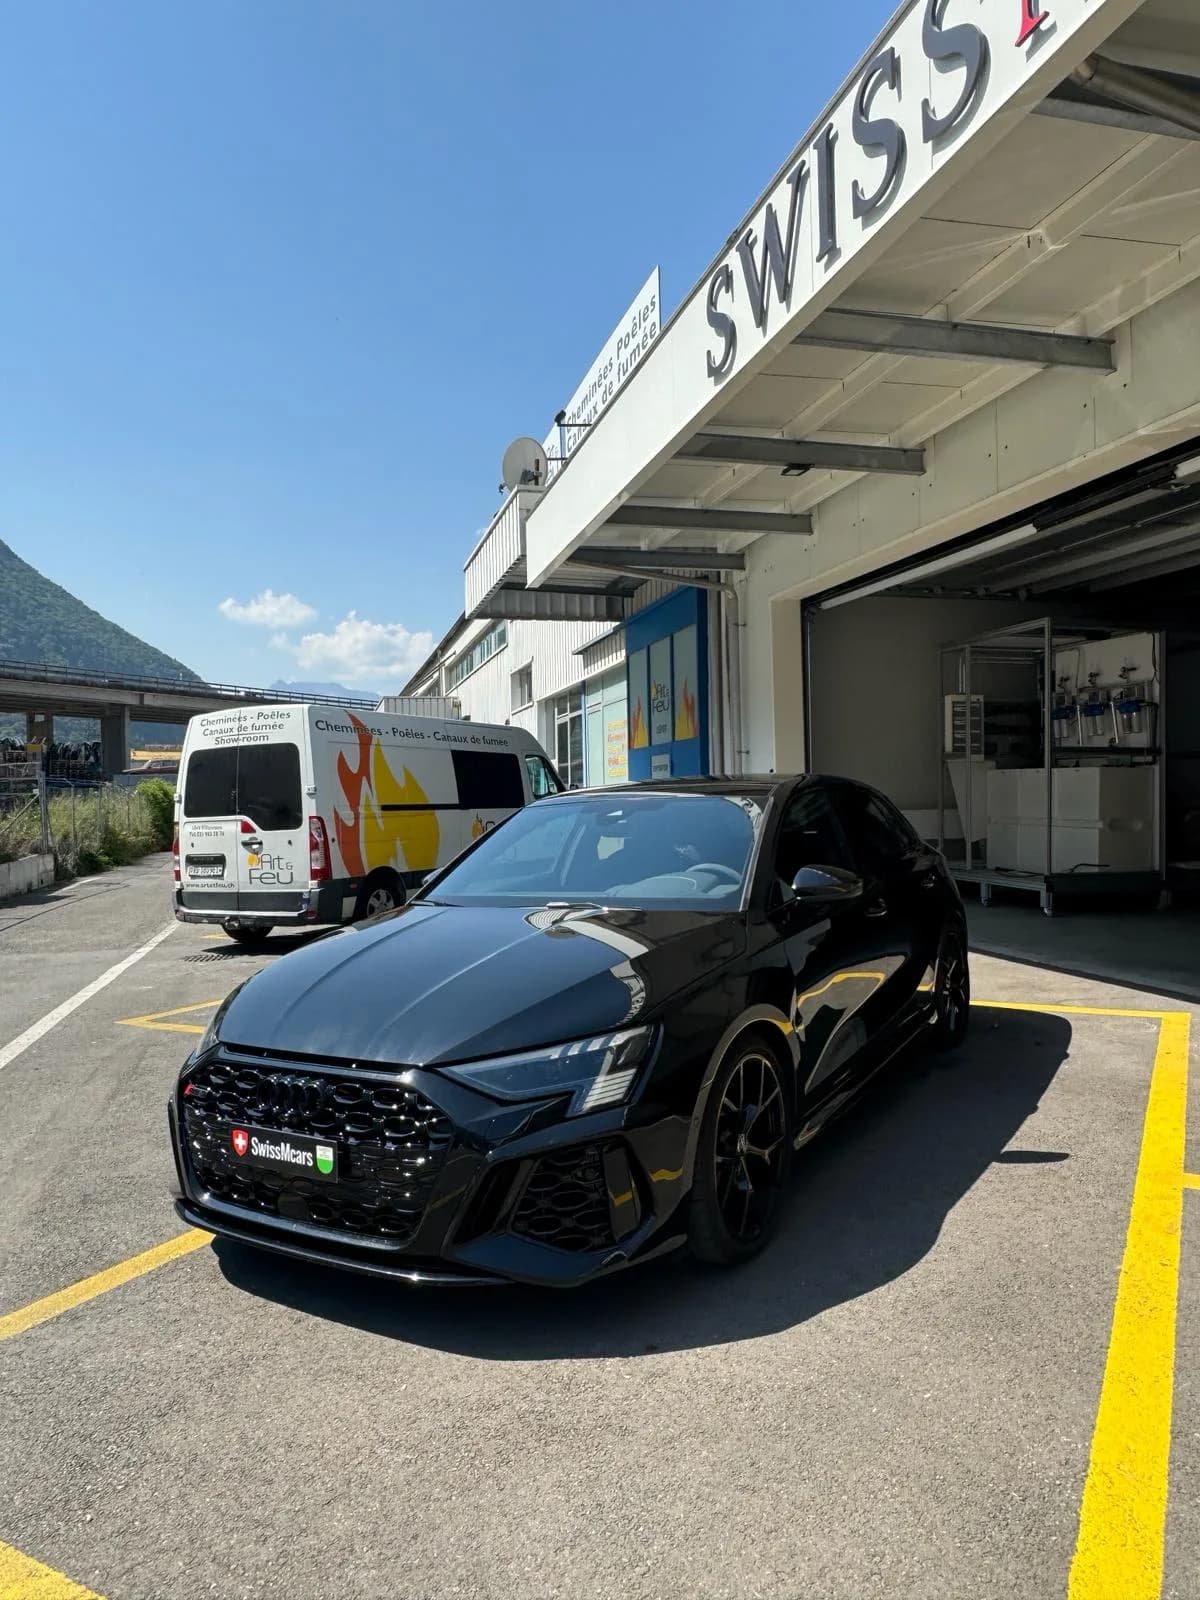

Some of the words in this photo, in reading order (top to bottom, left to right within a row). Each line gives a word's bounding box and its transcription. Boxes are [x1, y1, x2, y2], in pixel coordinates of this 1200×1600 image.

[706, 0, 1049, 379] SWISS
[566, 355, 613, 434] Cheminées
[616, 294, 656, 360] Poêles
[567, 401, 598, 453] Canaux
[602, 380, 613, 405] de
[617, 321, 657, 383] fumée
[200, 714, 247, 727] Cheminées
[257, 711, 291, 720] Poêles
[202, 726, 234, 737] Canaux
[237, 724, 248, 733] de
[251, 721, 285, 732] fumée
[214, 734, 269, 746] Show-room
[391, 727, 425, 739] Poêles
[433, 731, 468, 744] Canaux
[470, 735, 481, 745] de
[482, 736, 510, 747] fumée
[261, 853, 285, 870] Art
[250, 1135, 313, 1167] SwissMcars
